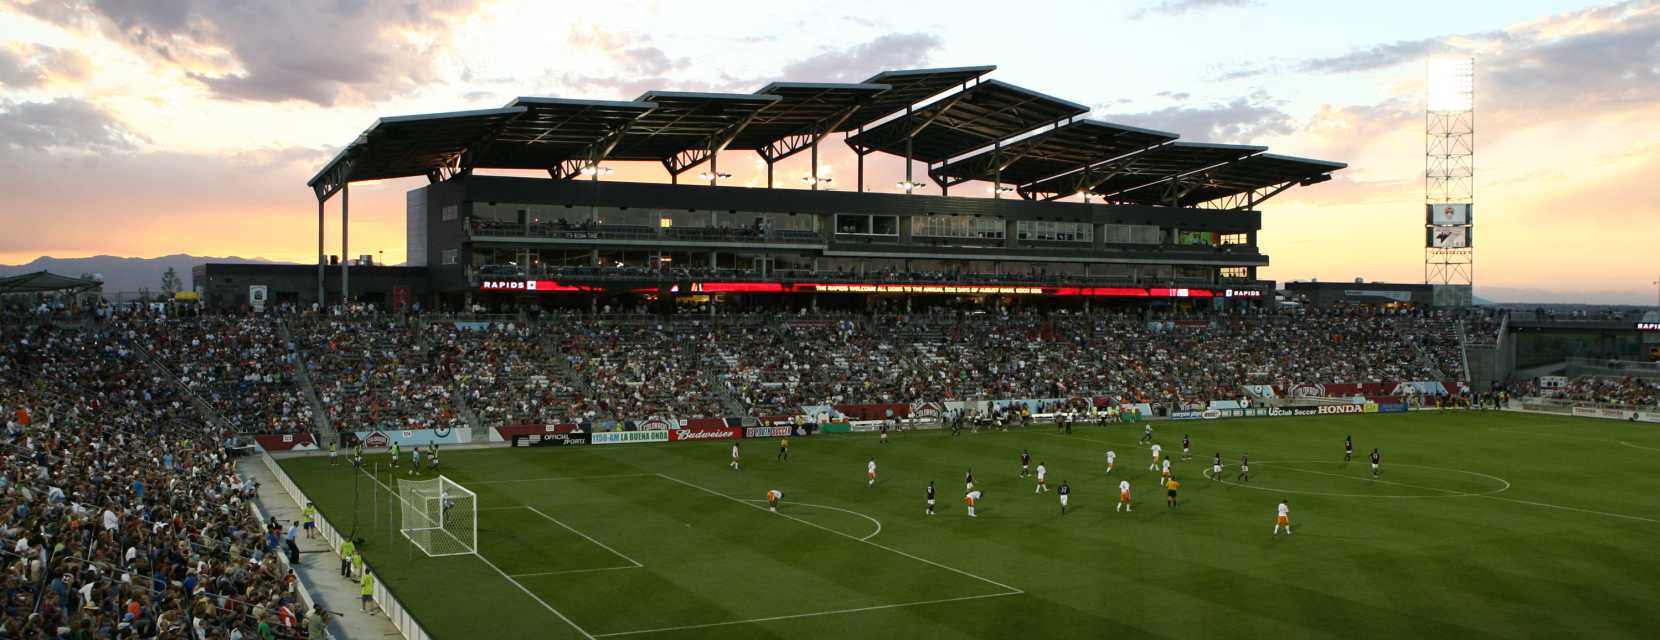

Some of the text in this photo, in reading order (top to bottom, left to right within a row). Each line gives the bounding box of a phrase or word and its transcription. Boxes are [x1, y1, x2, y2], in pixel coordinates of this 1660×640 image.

[484, 281, 525, 289] RAPIDS
[1318, 403, 1363, 414] HONDA
[621, 432, 629, 441] LA
[630, 431, 650, 441] BUENA
[651, 431, 667, 440] ONDA
[676, 430, 734, 441] Budweiser
